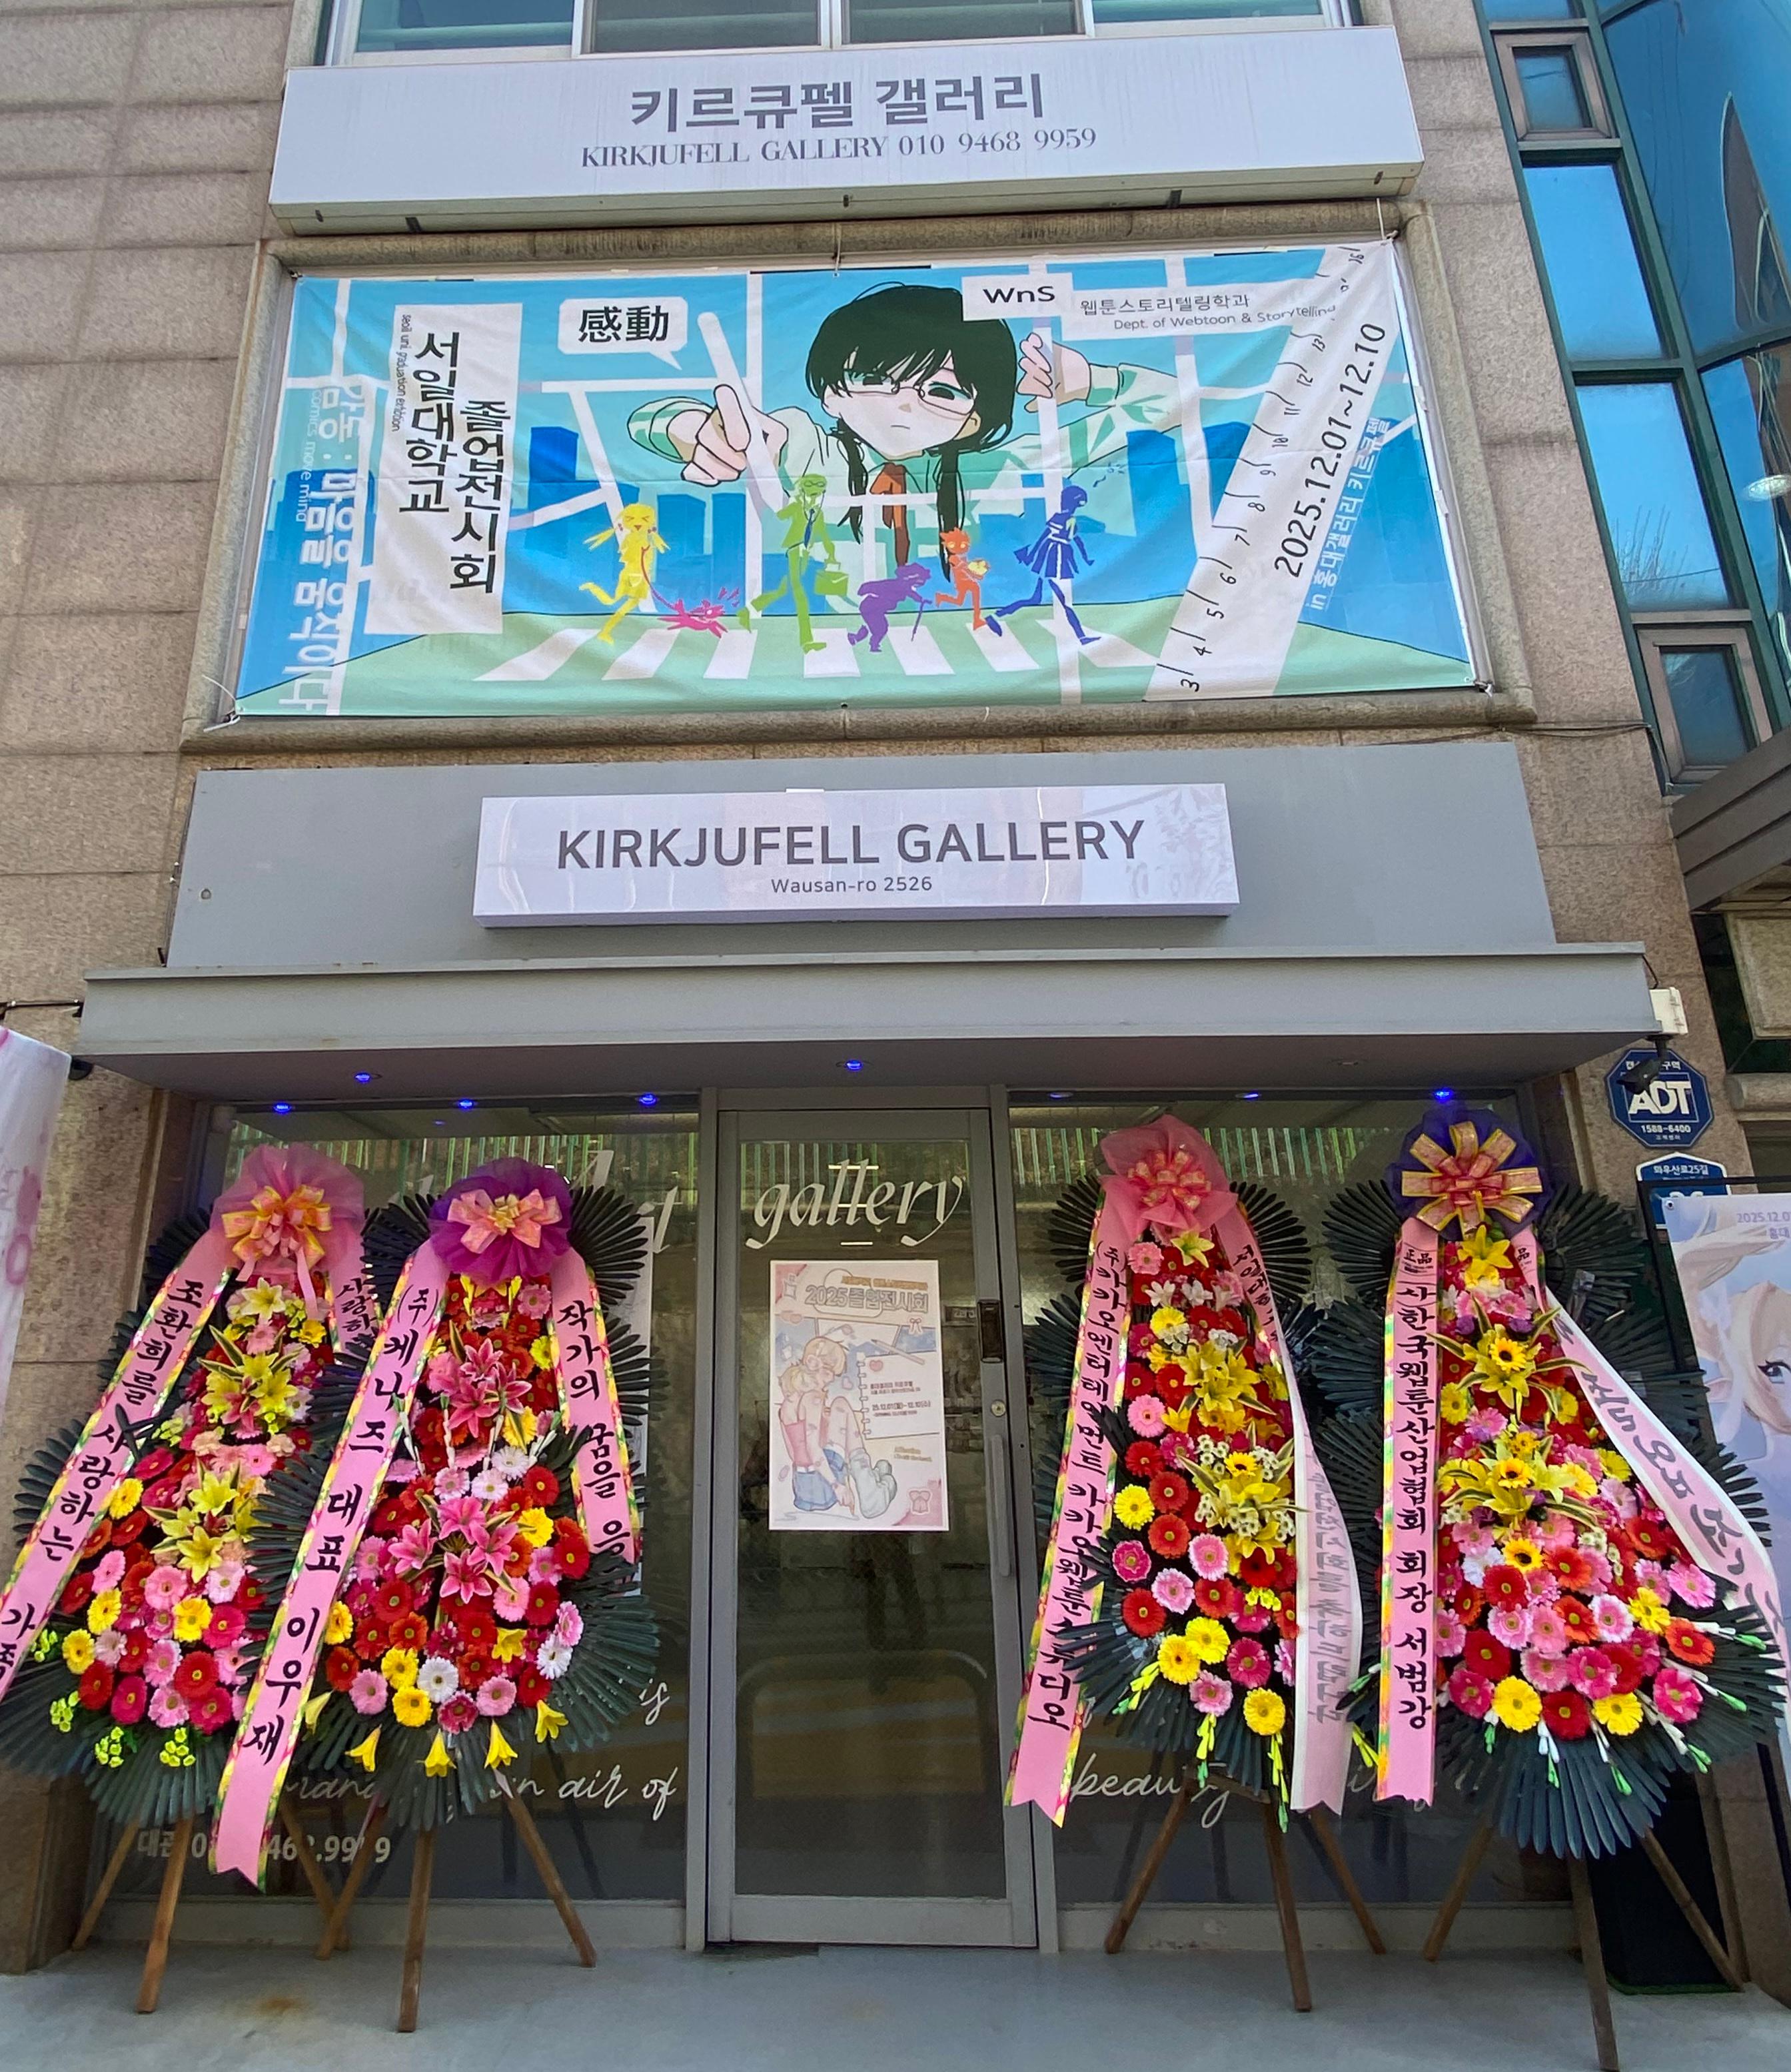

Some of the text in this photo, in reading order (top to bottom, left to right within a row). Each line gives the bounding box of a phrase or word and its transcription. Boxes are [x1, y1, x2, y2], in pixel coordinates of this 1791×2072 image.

[631, 73, 1044, 133] 키르큐펠 갤러리
[581, 127, 1097, 168] KIRKJUFELL GALLERY 010 9468 9959
[983, 285, 1055, 304] WnS
[1080, 293, 1250, 316] 웹툰스토리텔링학과
[1153, 316, 1167, 328] of
[1170, 312, 1236, 328] Webtoon
[1242, 312, 1252, 324] &
[578, 305, 670, 343] 感動
[1295, 371, 1314, 388] 12
[399, 331, 460, 513] 서일대학교
[295, 388, 323, 523] comics move mind
[1273, 323, 1385, 579] 2025.12.01~12.10
[300, 472, 357, 568] 마음을
[450, 400, 511, 594] 졸업전시회
[1247, 501, 1266, 513] 8
[1234, 533, 1252, 547] 7
[1313, 495, 1364, 588] 홍대갤러리
[1220, 571, 1237, 586] 6
[1305, 593, 1327, 610] in
[1207, 607, 1225, 620] 5
[278, 577, 345, 712] 움직이다
[1193, 645, 1213, 656] 4
[1180, 678, 1200, 693] 3
[557, 819, 1145, 870] KIRKJUFELL GALLERY
[771, 875, 933, 895] Wausan-ro 2526
[1628, 1080, 1692, 1115] ADT
[745, 1158, 966, 1250] gallery
[335, 1277, 378, 1349] 사랑하
[556, 1299, 600, 1401] 작가의
[304, 1483, 364, 1574] 대표
[1395, 1550, 1433, 1614] 회장
[242, 1607, 320, 1767] 이우재
[1394, 1627, 1433, 1730] 서범강
[558, 1764, 628, 1808] air
[642, 1767, 678, 1821] of
[1069, 1752, 1231, 1829] beauy
